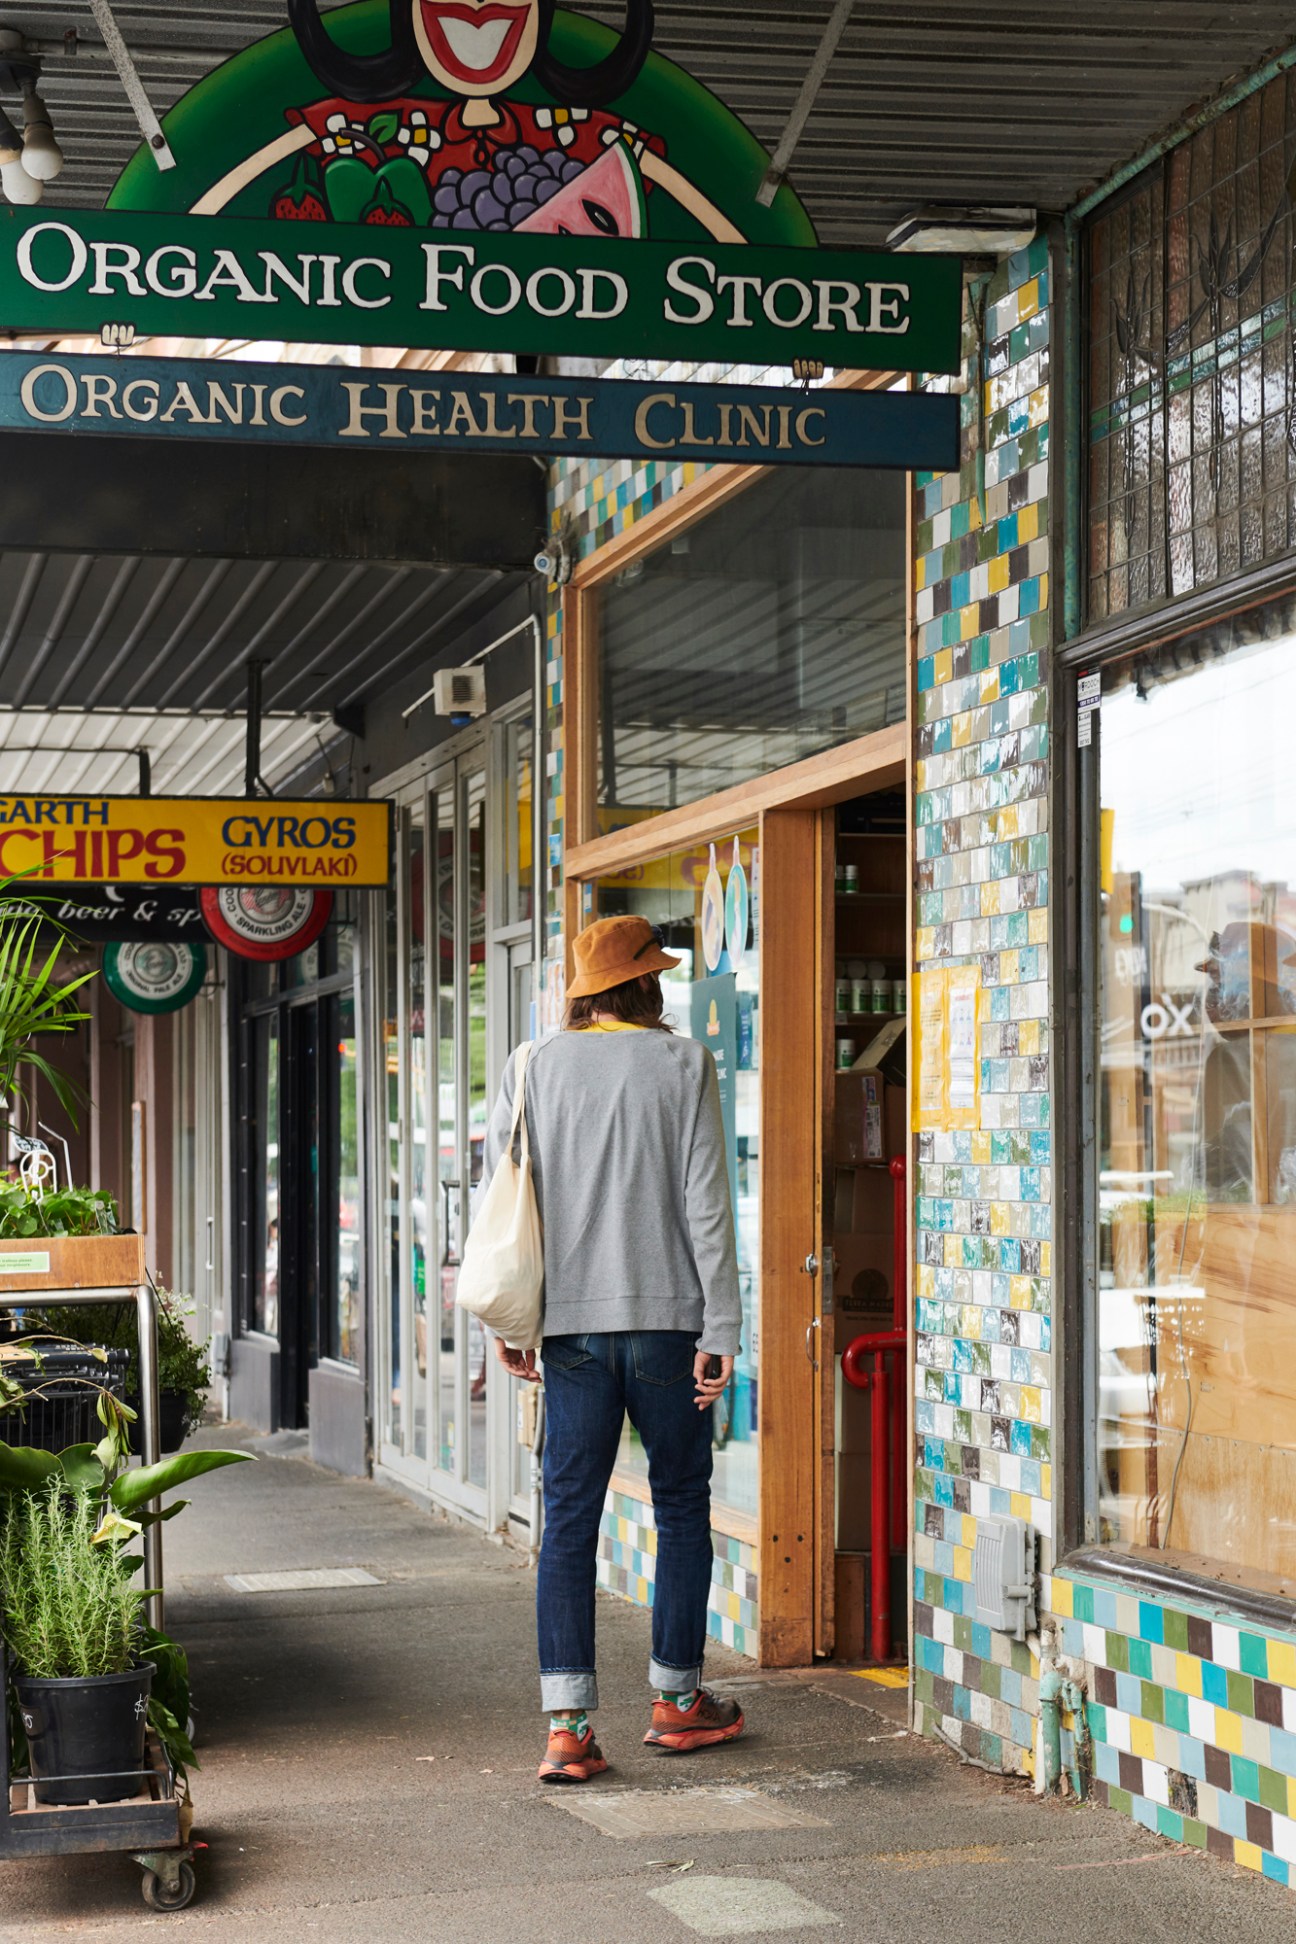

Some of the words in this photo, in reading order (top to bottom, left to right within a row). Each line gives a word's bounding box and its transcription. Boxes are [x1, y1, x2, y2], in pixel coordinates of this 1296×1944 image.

[17, 222, 392, 308] ORGANIC
[419, 243, 629, 319] FOOD
[664, 256, 911, 334] STORE
[20, 364, 308, 427] ORGANIC
[338, 381, 594, 440] HEALTH
[634, 393, 827, 449] CLINIC
[221, 815, 357, 849] GYROS
[0, 828, 187, 879] CHIPS
[221, 852, 358, 877] (SOUVLAKI)
[57, 899, 125, 920] beer
[132, 900, 159, 922] &
[236, 917, 293, 936] SPARKLING
[293, 903, 306, 923] ALE
